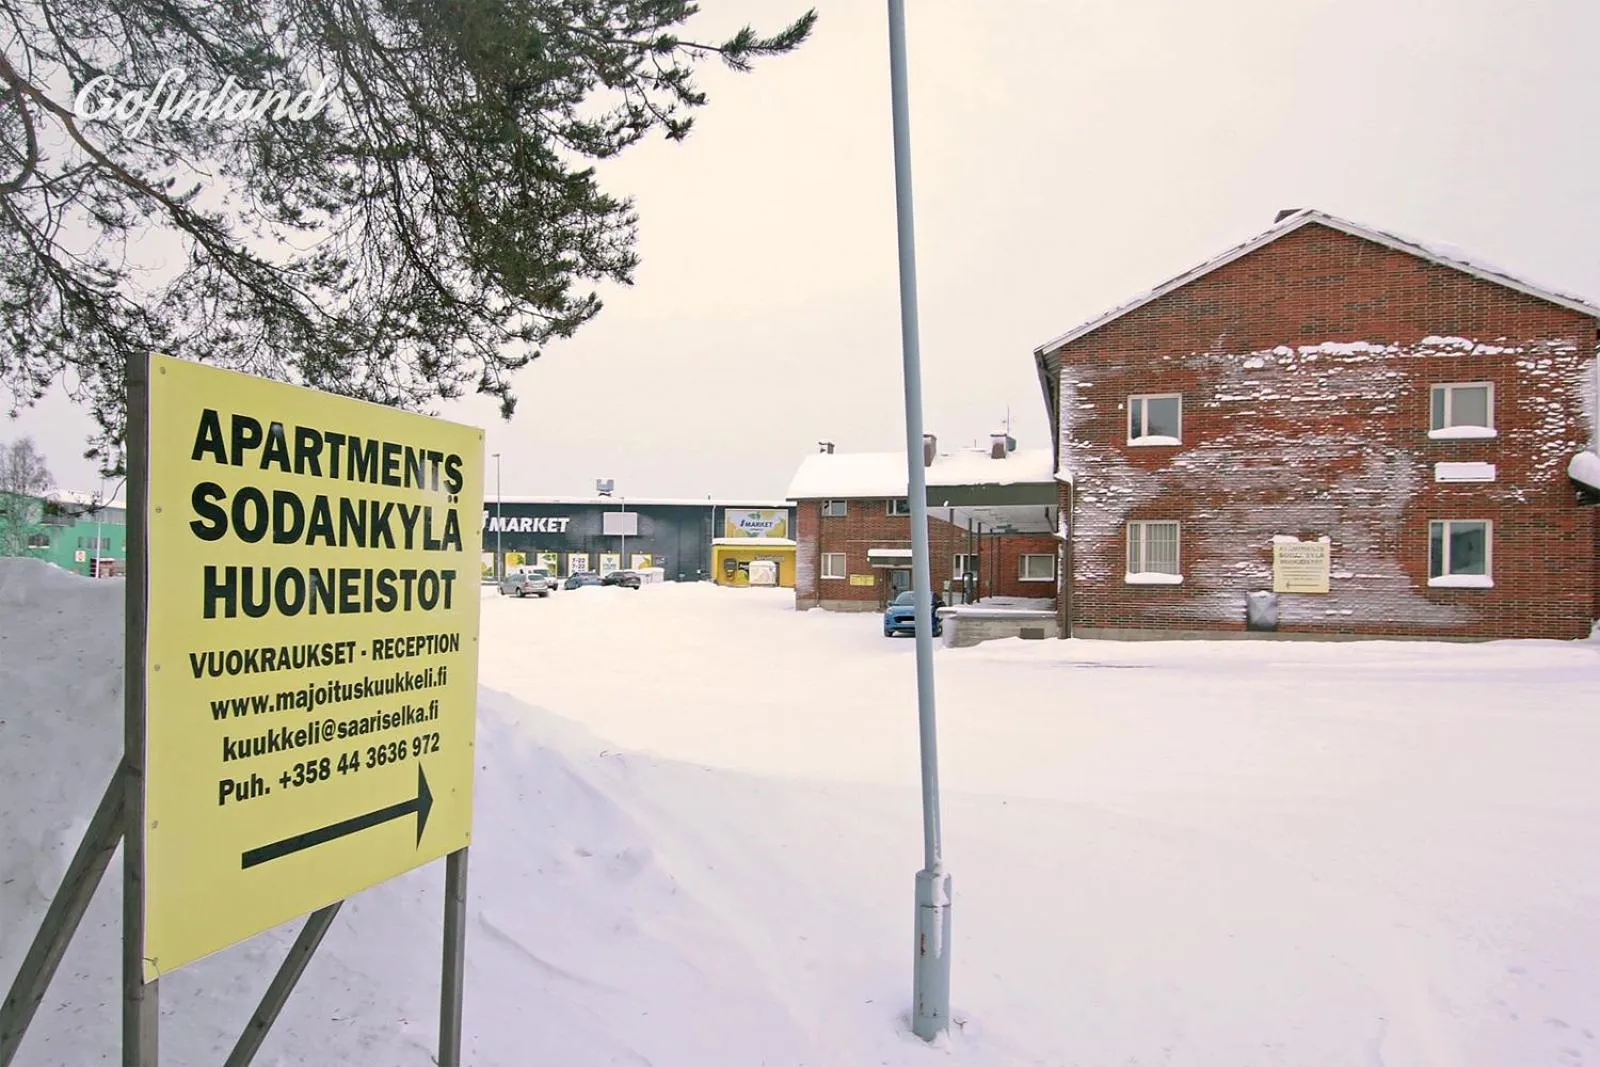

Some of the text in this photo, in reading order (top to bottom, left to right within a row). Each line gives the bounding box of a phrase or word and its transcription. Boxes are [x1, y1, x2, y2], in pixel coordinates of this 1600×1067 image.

[191, 408, 464, 495] APARTMENTS
[189, 481, 463, 552] SODANKYLÄ
[488, 516, 570, 533] MARKET
[203, 565, 457, 619] HUONEISTOT
[189, 641, 356, 679] VUOKRAUKSET
[372, 633, 460, 661] RECEPTION
[210, 666, 448, 720] www.majoituskuukkeli.fi
[222, 700, 439, 762] kuukkeli@saariselka.fi
[218, 732, 440, 806] Puh. +358 44 3636 972
